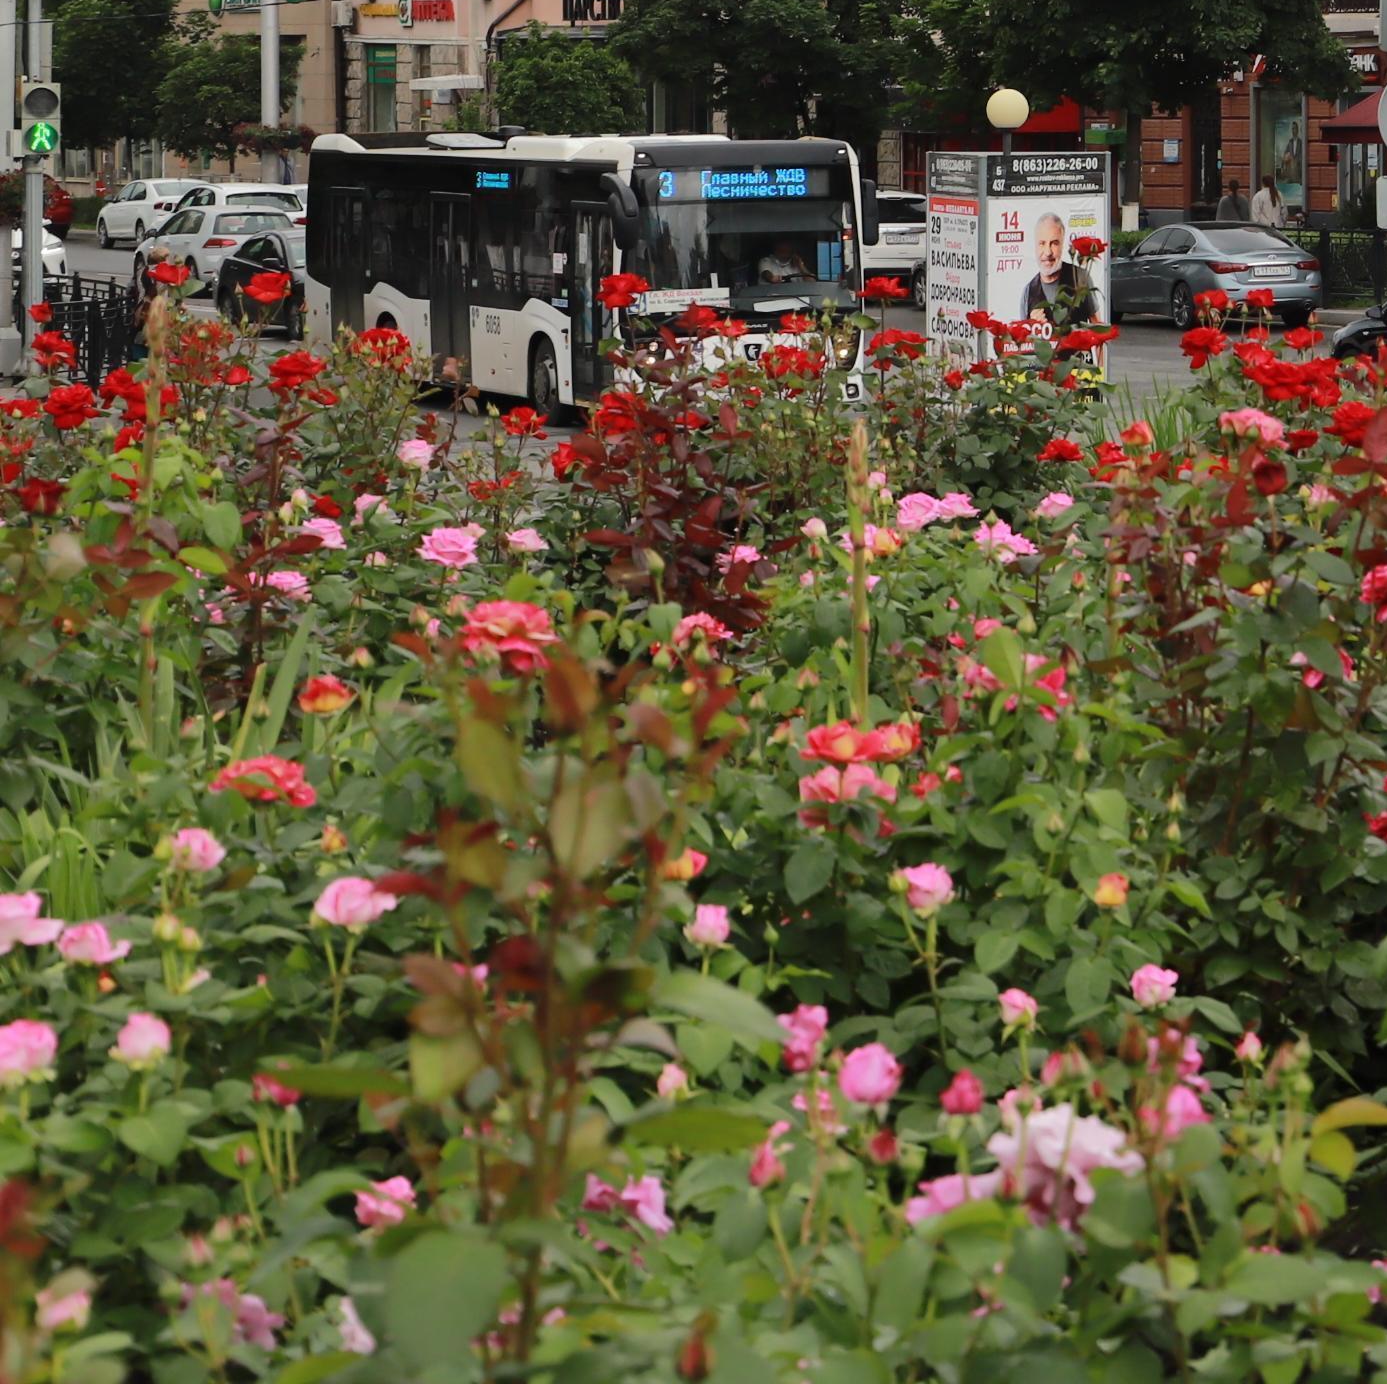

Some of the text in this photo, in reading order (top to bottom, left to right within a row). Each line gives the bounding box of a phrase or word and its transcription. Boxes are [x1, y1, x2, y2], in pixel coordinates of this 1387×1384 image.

[1012, 157, 1098, 174] 8(863)226-26-00
[659, 172, 674, 198] 3
[701, 168, 807, 186] Главный ЖДВ
[992, 179, 1005, 192] 437
[701, 184, 807, 199] Лесничество
[1027, 184, 1066, 192] «НАРУЖНАЯ
[1066, 183, 1099, 191] РЕКЛАМА»
[931, 216, 942, 234] 29
[1001, 211, 1019, 230] 14
[1001, 244, 1020, 254] 19:00
[931, 249, 976, 271] ВАСИЛЬЕВА
[996, 259, 1023, 273] ДГТУ
[931, 283, 976, 305] ДОБРОНРАВОВ
[931, 317, 976, 339] САФОНОВА
